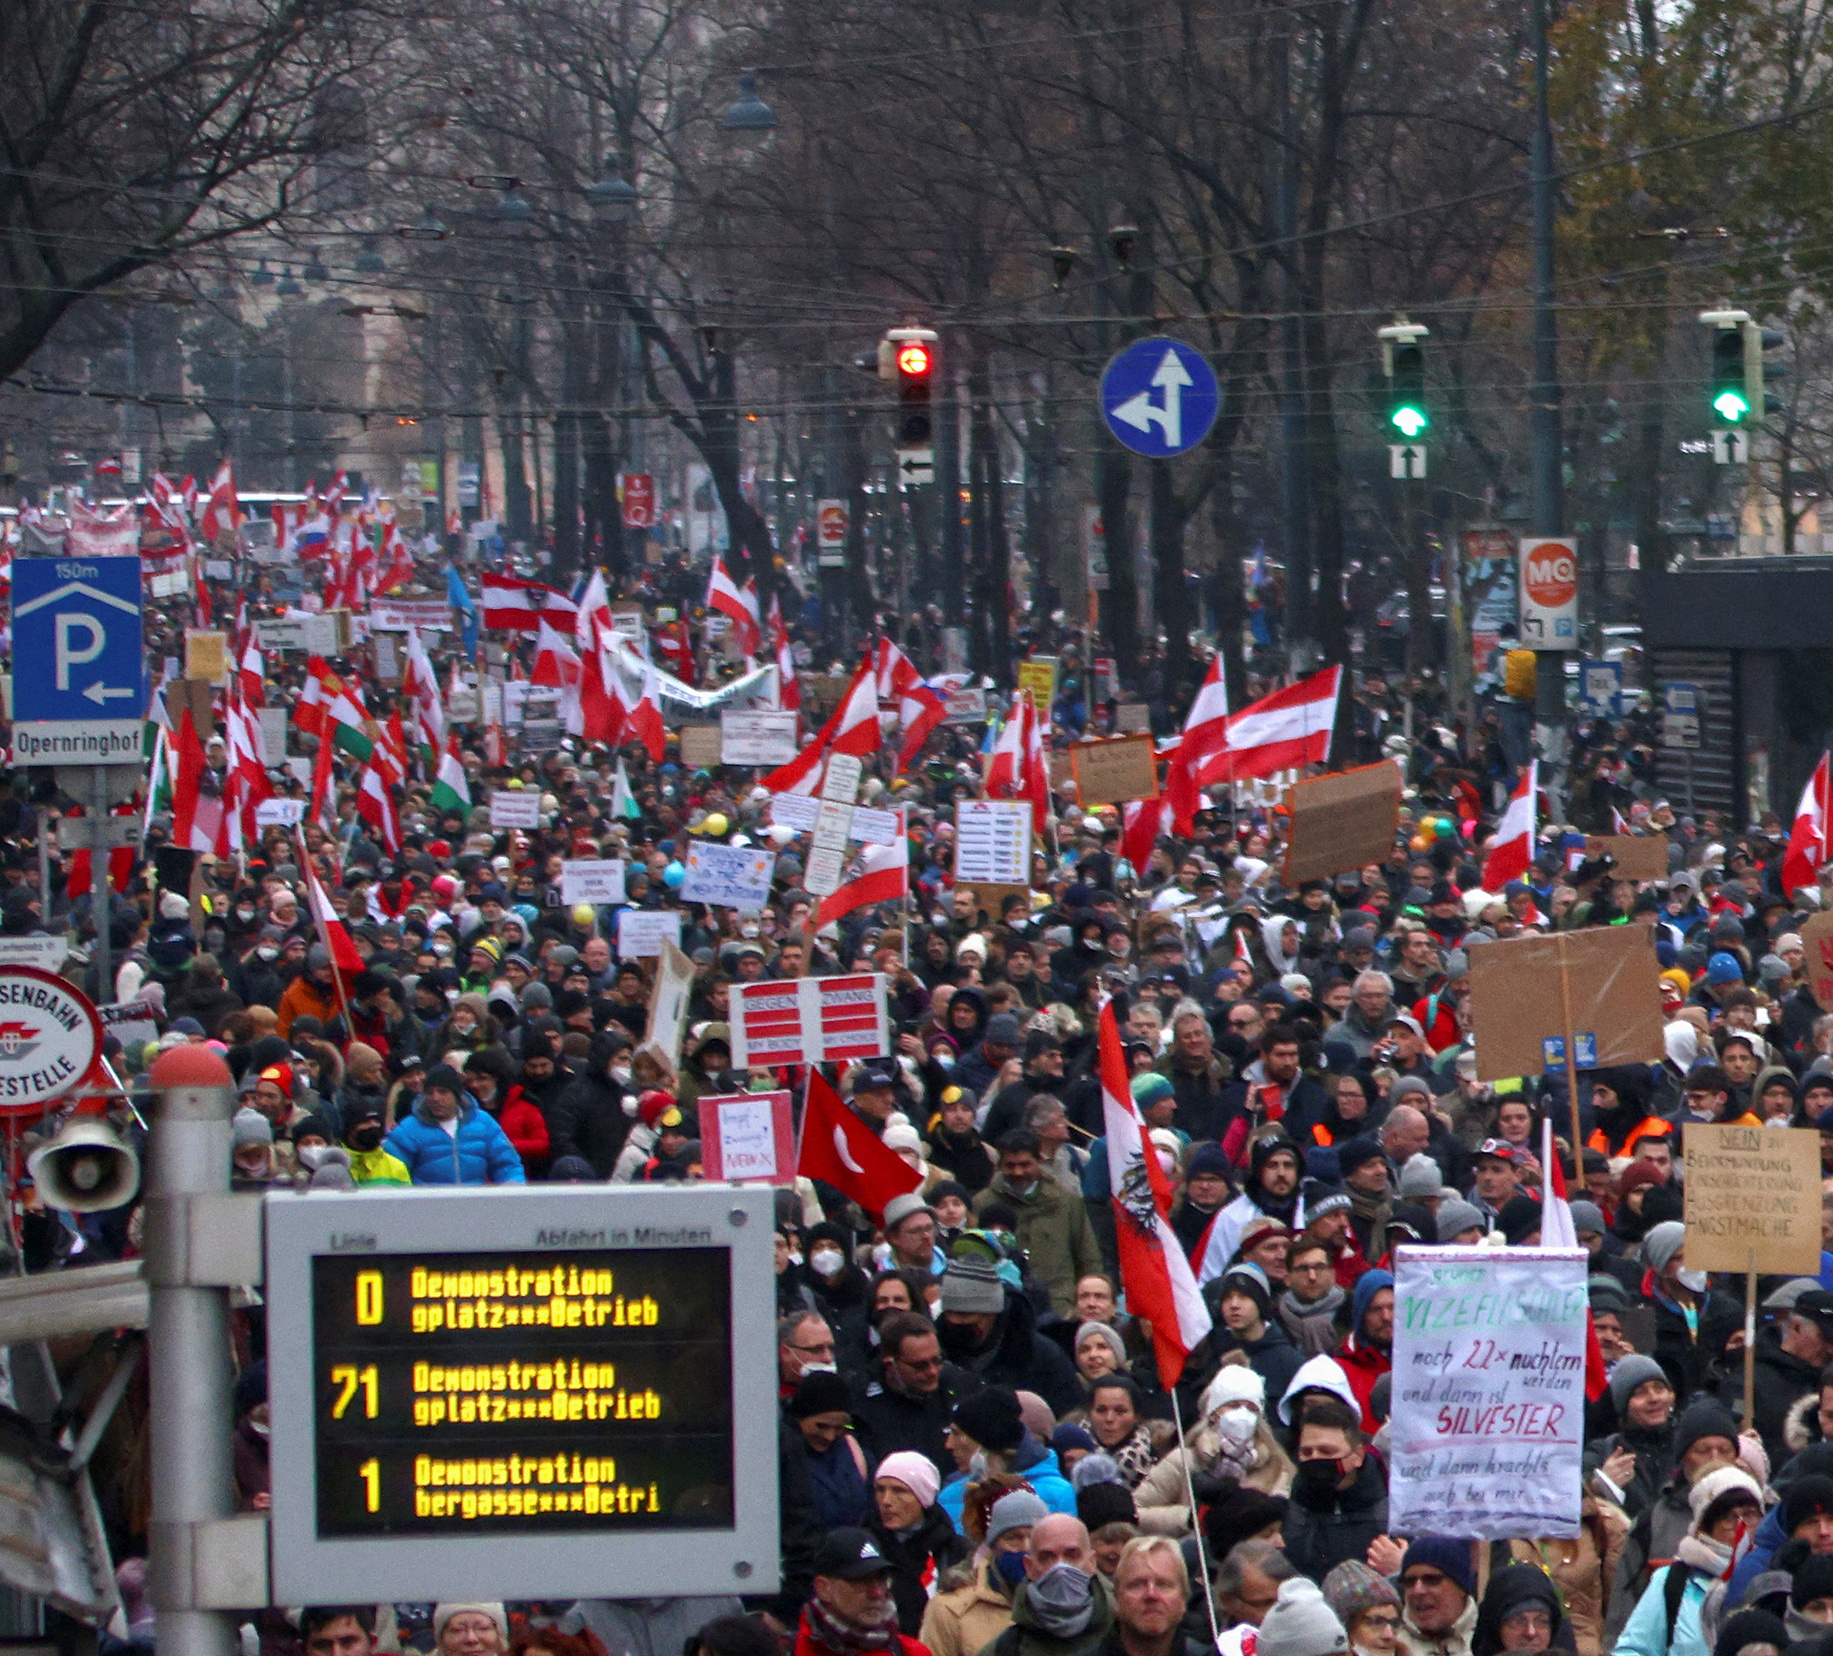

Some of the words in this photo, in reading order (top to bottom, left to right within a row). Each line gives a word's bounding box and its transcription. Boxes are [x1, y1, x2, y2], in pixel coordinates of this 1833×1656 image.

[1528, 558, 1575, 585] MQ
[18, 728, 140, 757] Opernringhof
[1719, 1128, 1760, 1149] NEIN
[411, 1264, 613, 1299] Demonstration
[331, 1362, 380, 1420] 71
[413, 1359, 616, 1393] Demonstration
[1439, 1379, 1483, 1403] dann
[1437, 1403, 1566, 1437] SILVESTER
[358, 1456, 380, 1514] 1
[414, 1452, 616, 1487] Demonstration
